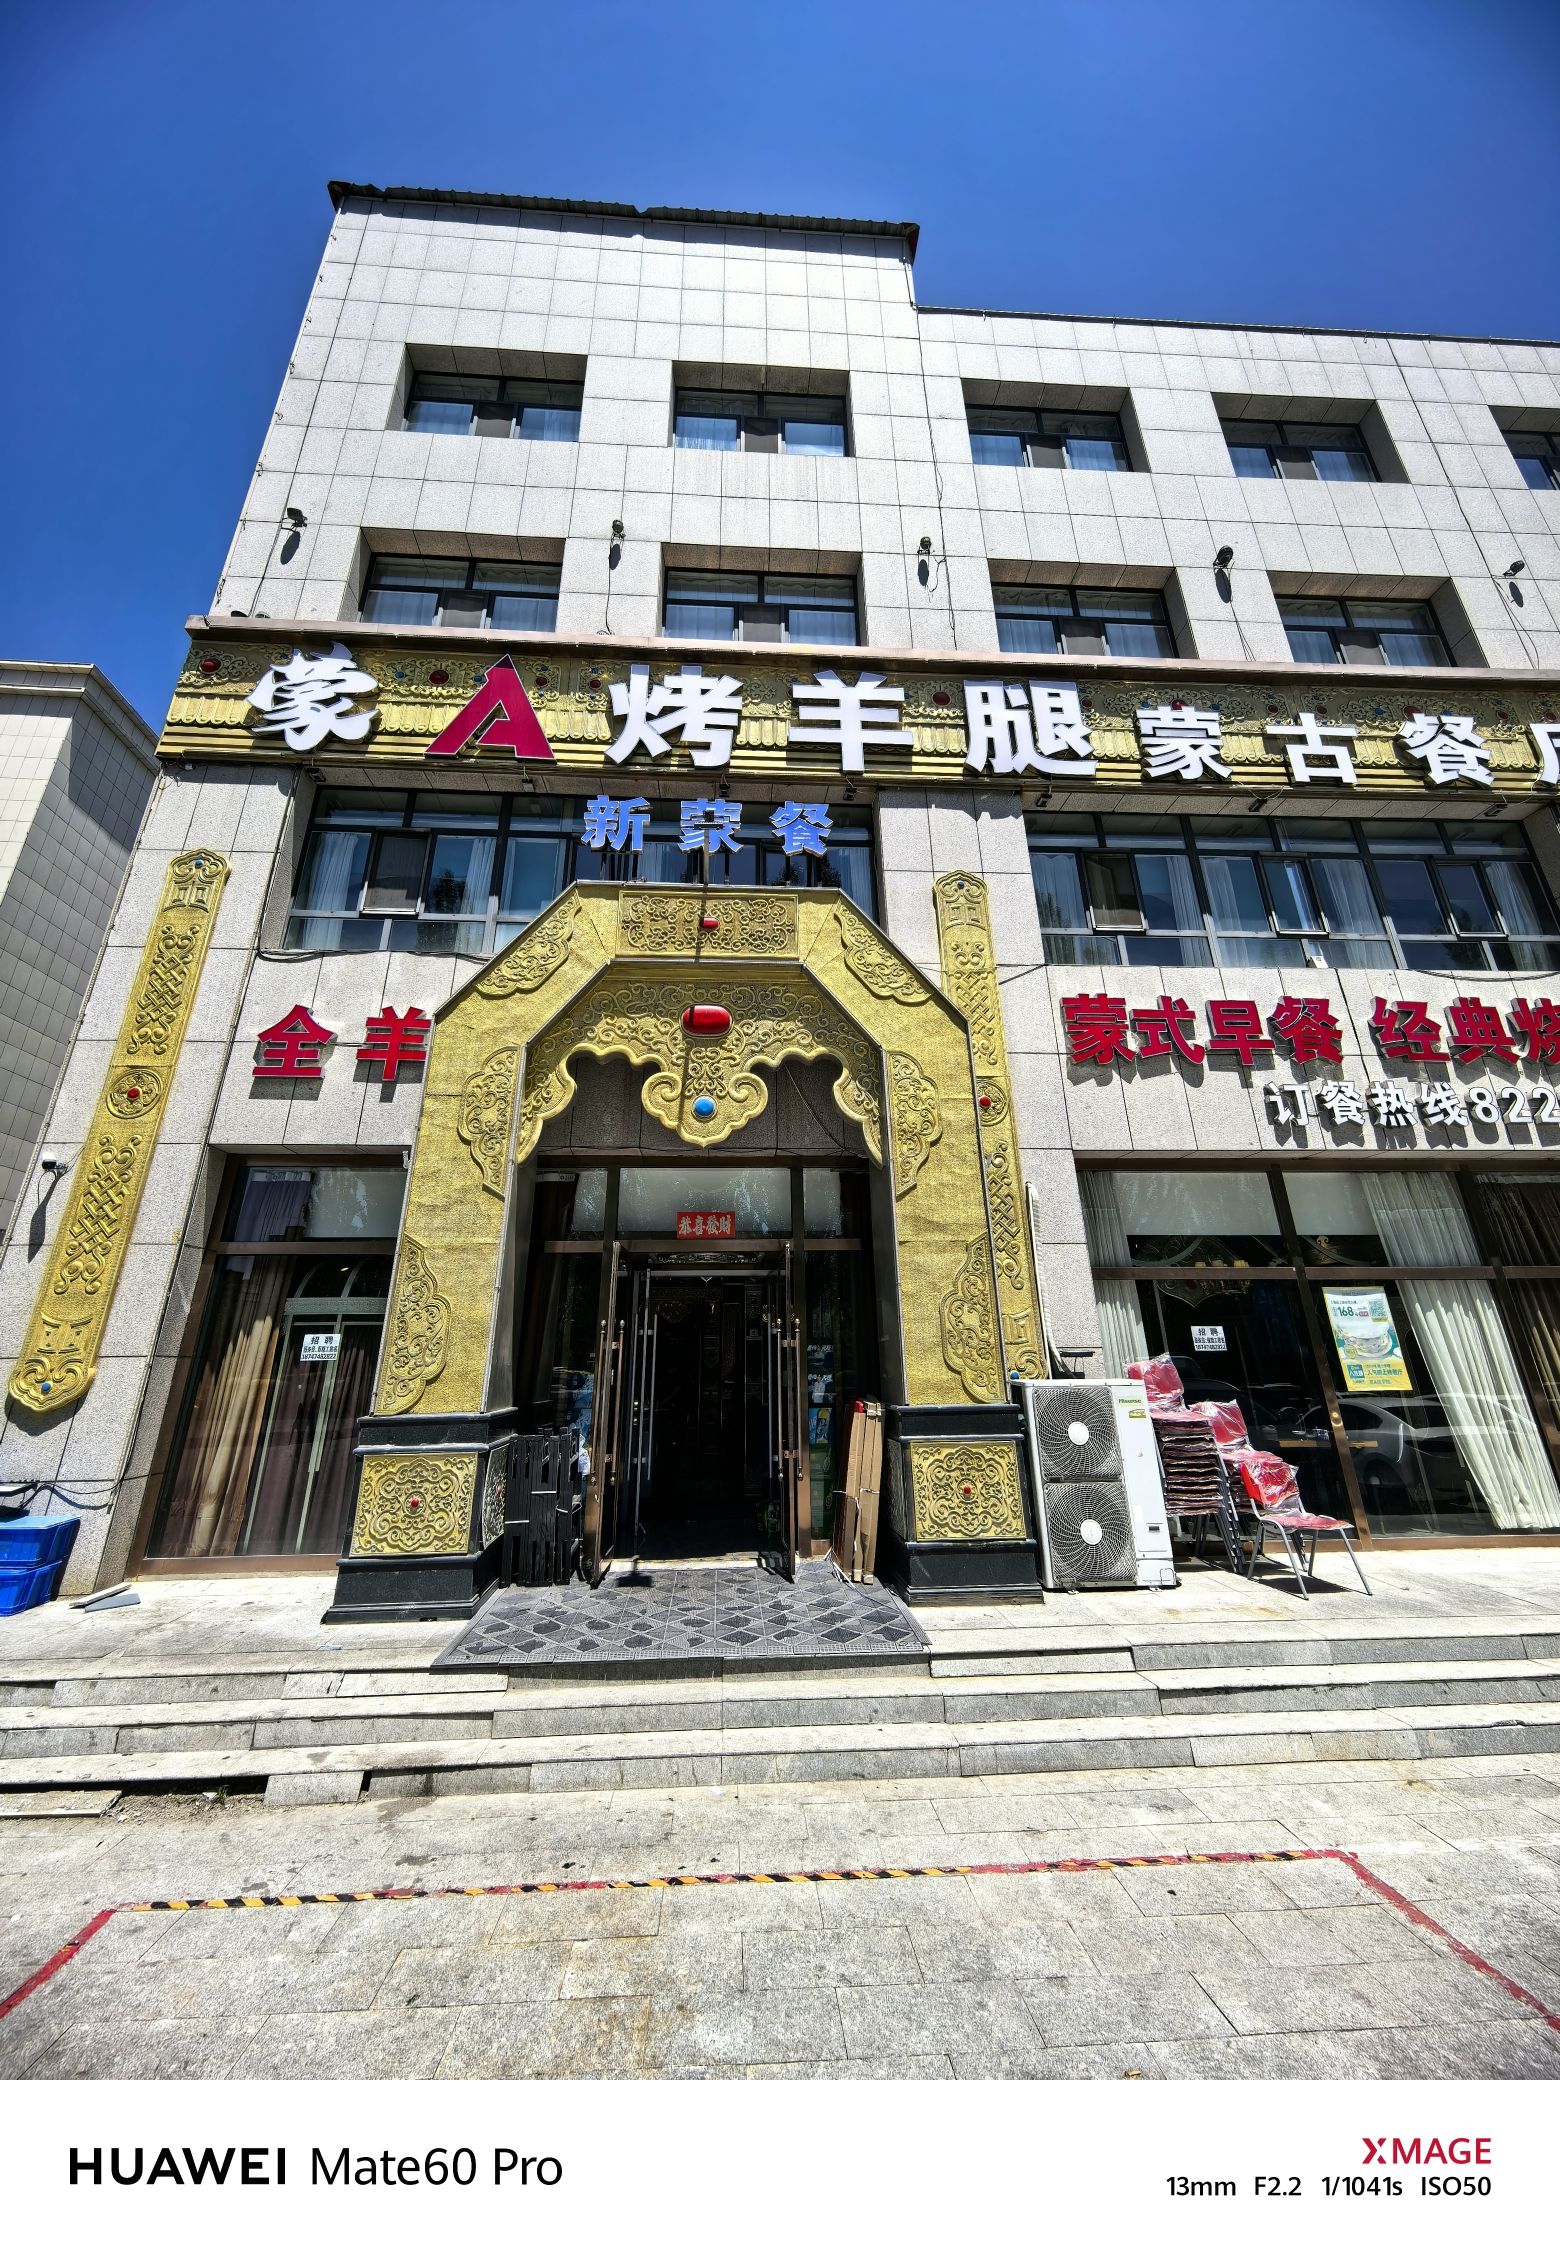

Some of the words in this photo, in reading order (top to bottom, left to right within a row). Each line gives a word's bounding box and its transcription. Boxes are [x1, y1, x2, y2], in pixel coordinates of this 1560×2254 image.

[581, 795, 834, 857] 新蒙餐
[251, 1004, 432, 1081] 全羊
[1060, 993, 1344, 1066] 蒙式早餐
[311, 1336, 334, 1345] 招聘
[1337, 1306, 1354, 1317] 168
